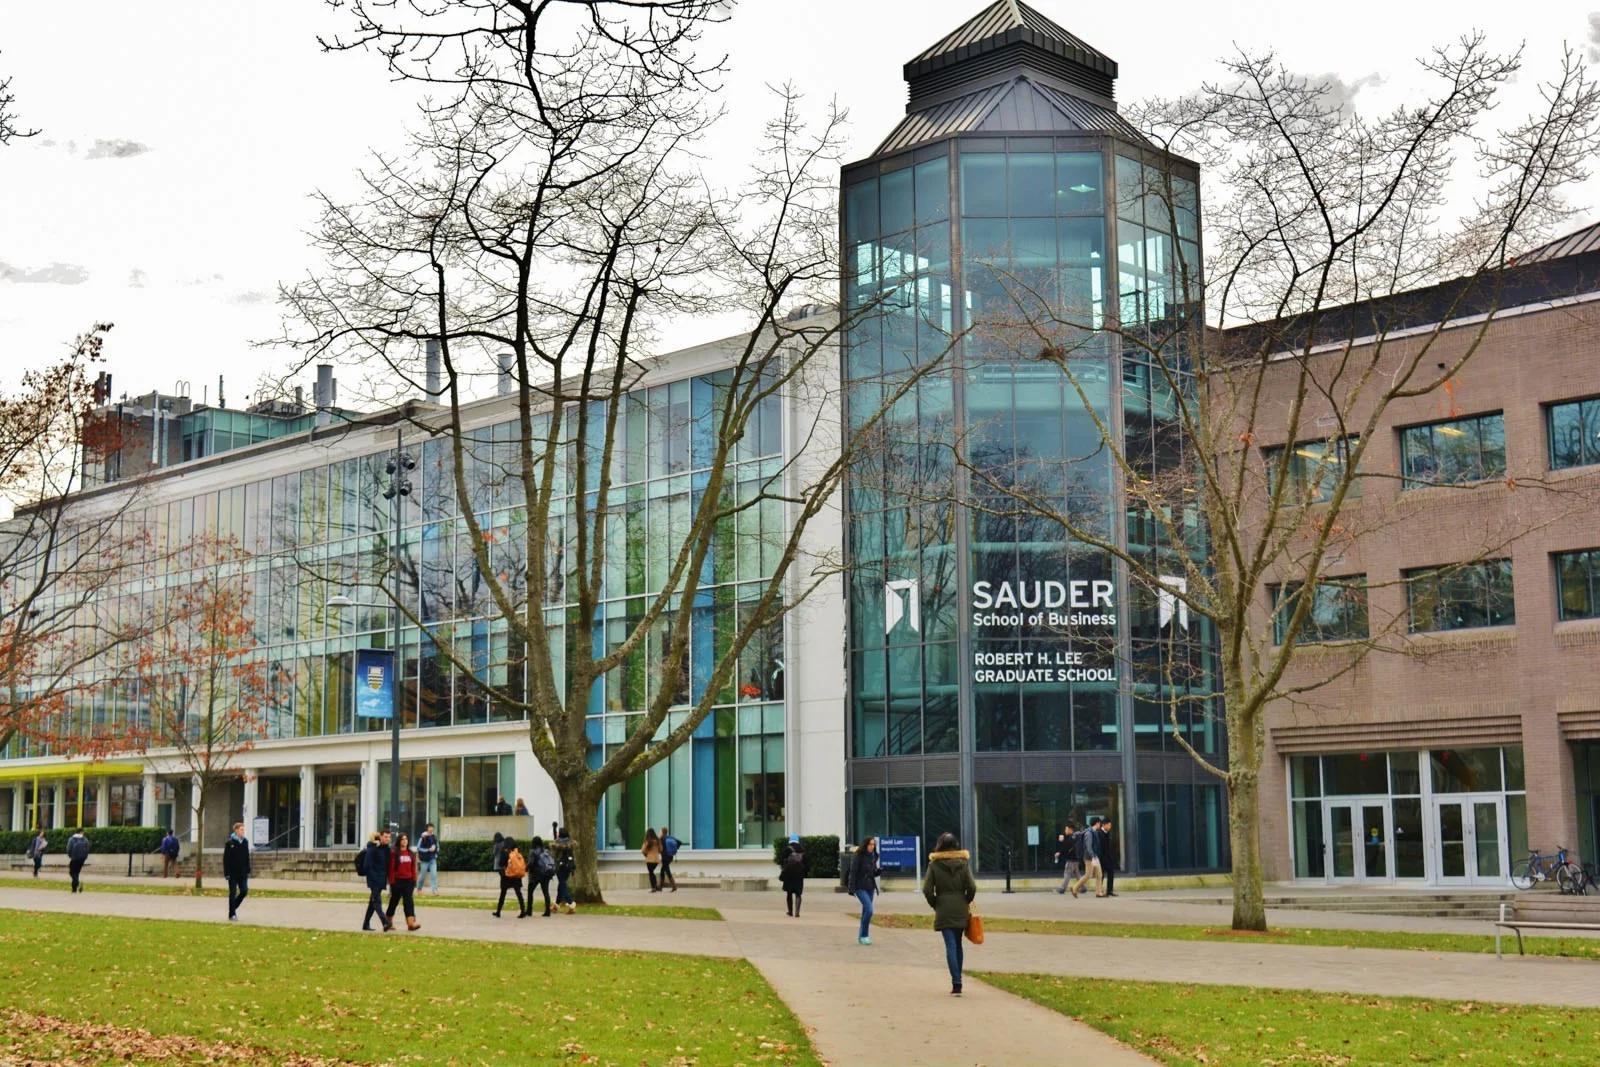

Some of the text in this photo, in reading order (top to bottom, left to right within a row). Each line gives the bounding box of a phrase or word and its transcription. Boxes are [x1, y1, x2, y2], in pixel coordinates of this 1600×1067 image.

[973, 580, 1114, 608] SAUDER
[973, 611, 1116, 626] School of Business
[975, 652, 1082, 665] ROBERT H. LEE
[975, 668, 1116, 682] GRADUATE SCHOOL
